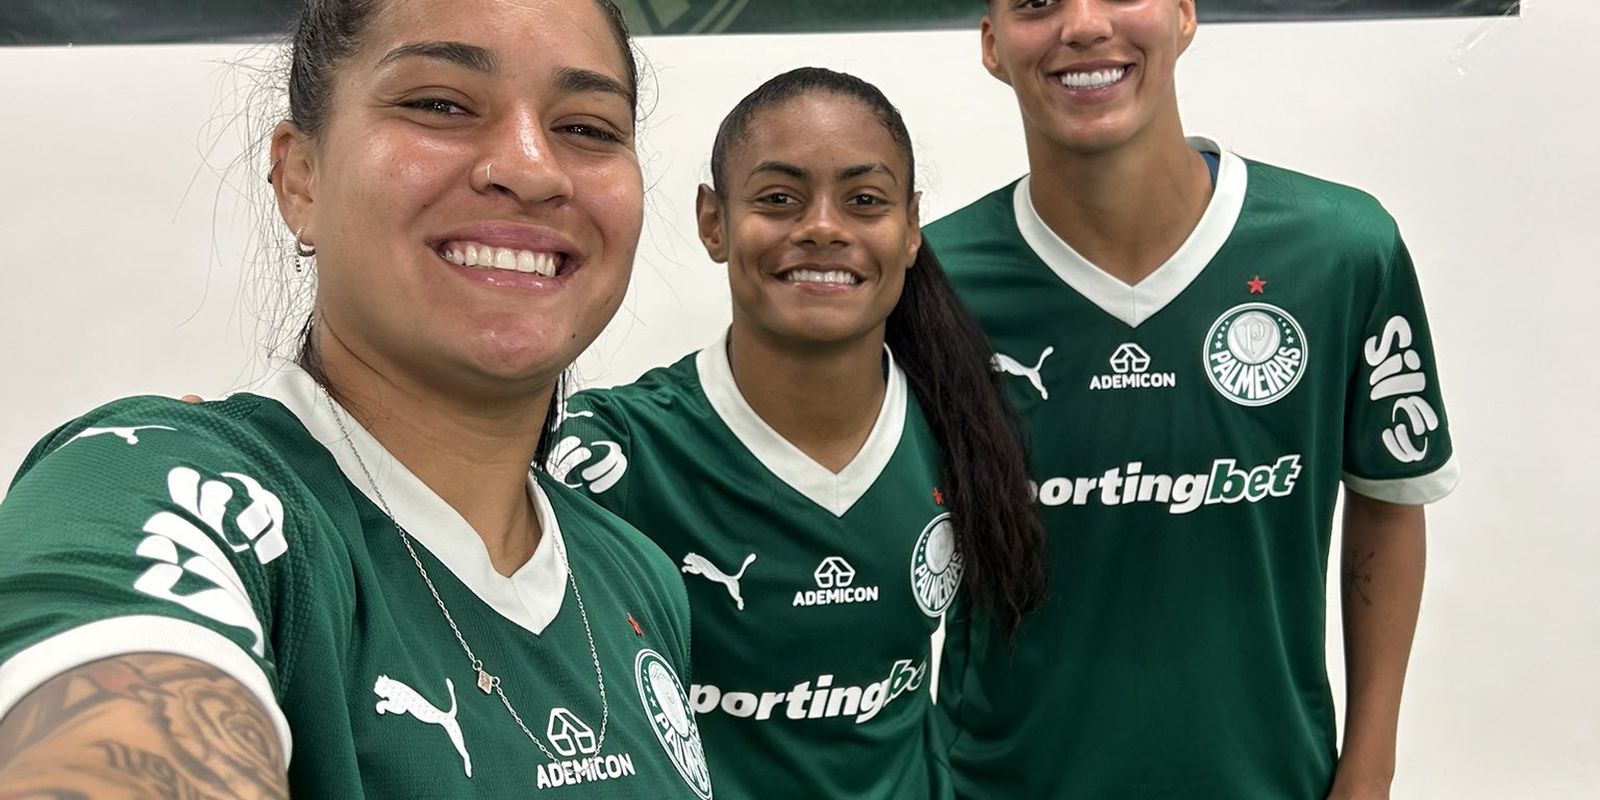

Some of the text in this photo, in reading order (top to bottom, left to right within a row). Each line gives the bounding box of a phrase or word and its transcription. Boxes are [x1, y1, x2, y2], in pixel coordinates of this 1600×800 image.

[1089, 372, 1176, 390] ADEMICON
[1210, 346, 1301, 400] PALMEIRAS
[1026, 454, 1301, 514] ortingbet
[792, 586, 879, 607] ADEMICON
[689, 656, 928, 724] portingbe
[537, 752, 636, 790] ADEMICON
